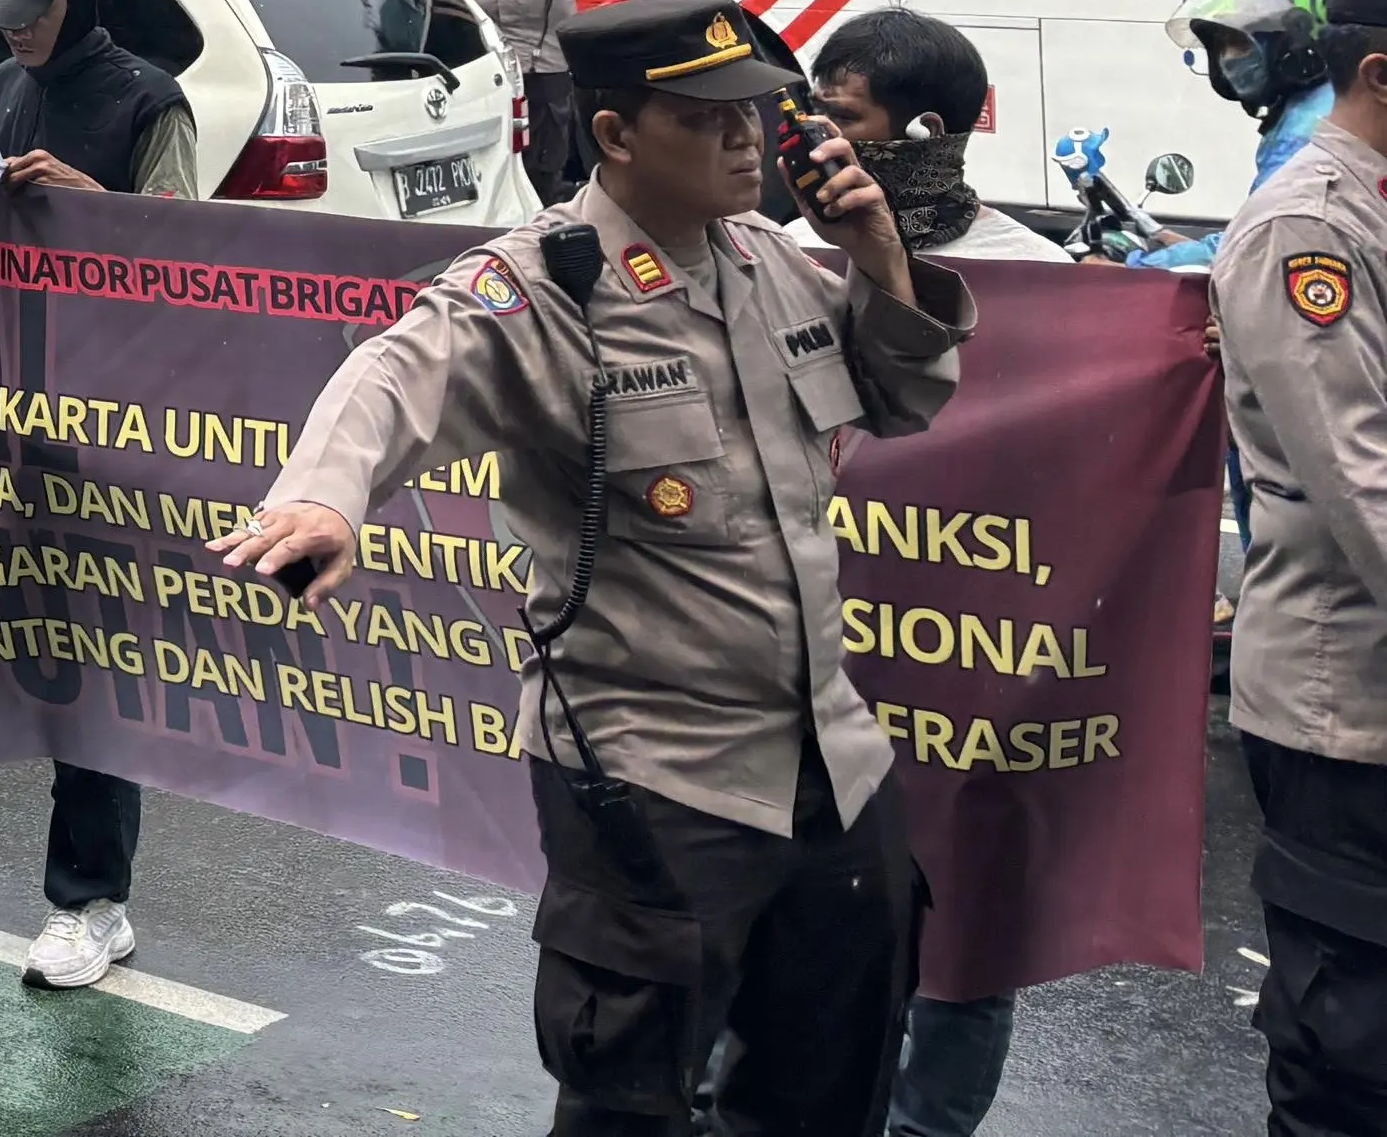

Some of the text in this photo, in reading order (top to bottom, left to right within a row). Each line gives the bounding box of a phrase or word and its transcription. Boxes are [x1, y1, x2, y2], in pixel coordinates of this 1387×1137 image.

[139, 266, 259, 307] PUSAT
[592, 364, 688, 395] RAWAN
[45, 471, 149, 530] DAN
[154, 565, 324, 635] PERDA
[326, 599, 493, 667] YANG
[875, 700, 1121, 773] FRASER
[156, 644, 264, 702] DAN
[278, 679, 458, 746] RELISH
